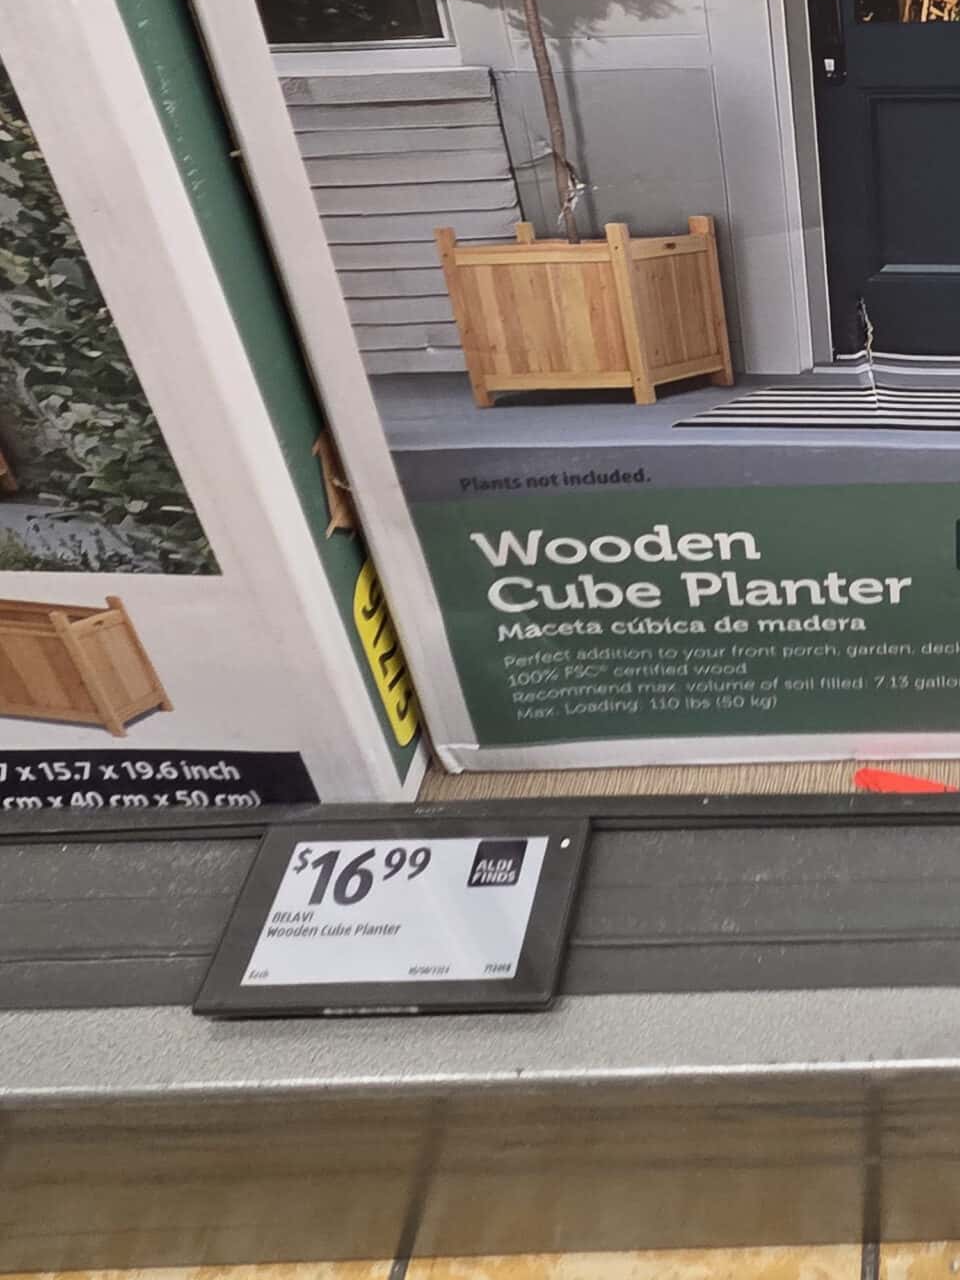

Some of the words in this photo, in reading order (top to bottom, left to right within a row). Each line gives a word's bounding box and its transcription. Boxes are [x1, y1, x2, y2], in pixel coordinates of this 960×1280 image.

[459, 475, 522, 493] Plants
[526, 474, 558, 489] not
[563, 468, 651, 487] included.
[469, 524, 761, 568] Wooden
[487, 574, 662, 613] Cube
[680, 571, 912, 608] Planter
[497, 620, 604, 642] Maceta
[610, 617, 706, 635] cúbica
[713, 616, 749, 633] de
[758, 615, 866, 632] madera
[504, 649, 570, 668] Perfect
[576, 647, 653, 661] addition
[658, 647, 678, 659] to
[684, 647, 727, 661] your
[731, 644, 777, 658] front
[506, 669, 559, 687] 100%
[612, 662, 688, 677] certified
[694, 662, 748, 676] wood
[512, 680, 633, 704] Recommend
[686, 679, 751, 693] volume
[760, 677, 778, 690] of
[784, 677, 815, 690] soil
[685, 695, 711, 710] lbs
[715, 694, 745, 709] (50
[750, 694, 778, 711] kg)
[15, 765, 36, 782] x
[38, 761, 91, 782] 15.7
[98, 764, 119, 781] x
[121, 760, 178, 781] 19.6
[179, 760, 241, 781] inch
[2, 794, 43, 809] cm
[47, 794, 64, 808] x
[70, 790, 104, 808] 40
[108, 793, 149, 808] cm
[153, 793, 170, 808] x
[175, 790, 209, 808] 50
[476, 859, 512, 871] ALDI
[471, 872, 516, 884] FINDS
[272, 911, 314, 923] BELAVI
[267, 925, 318, 938] Wooden
[321, 924, 351, 936] Cube
[354, 923, 401, 936] Planter
